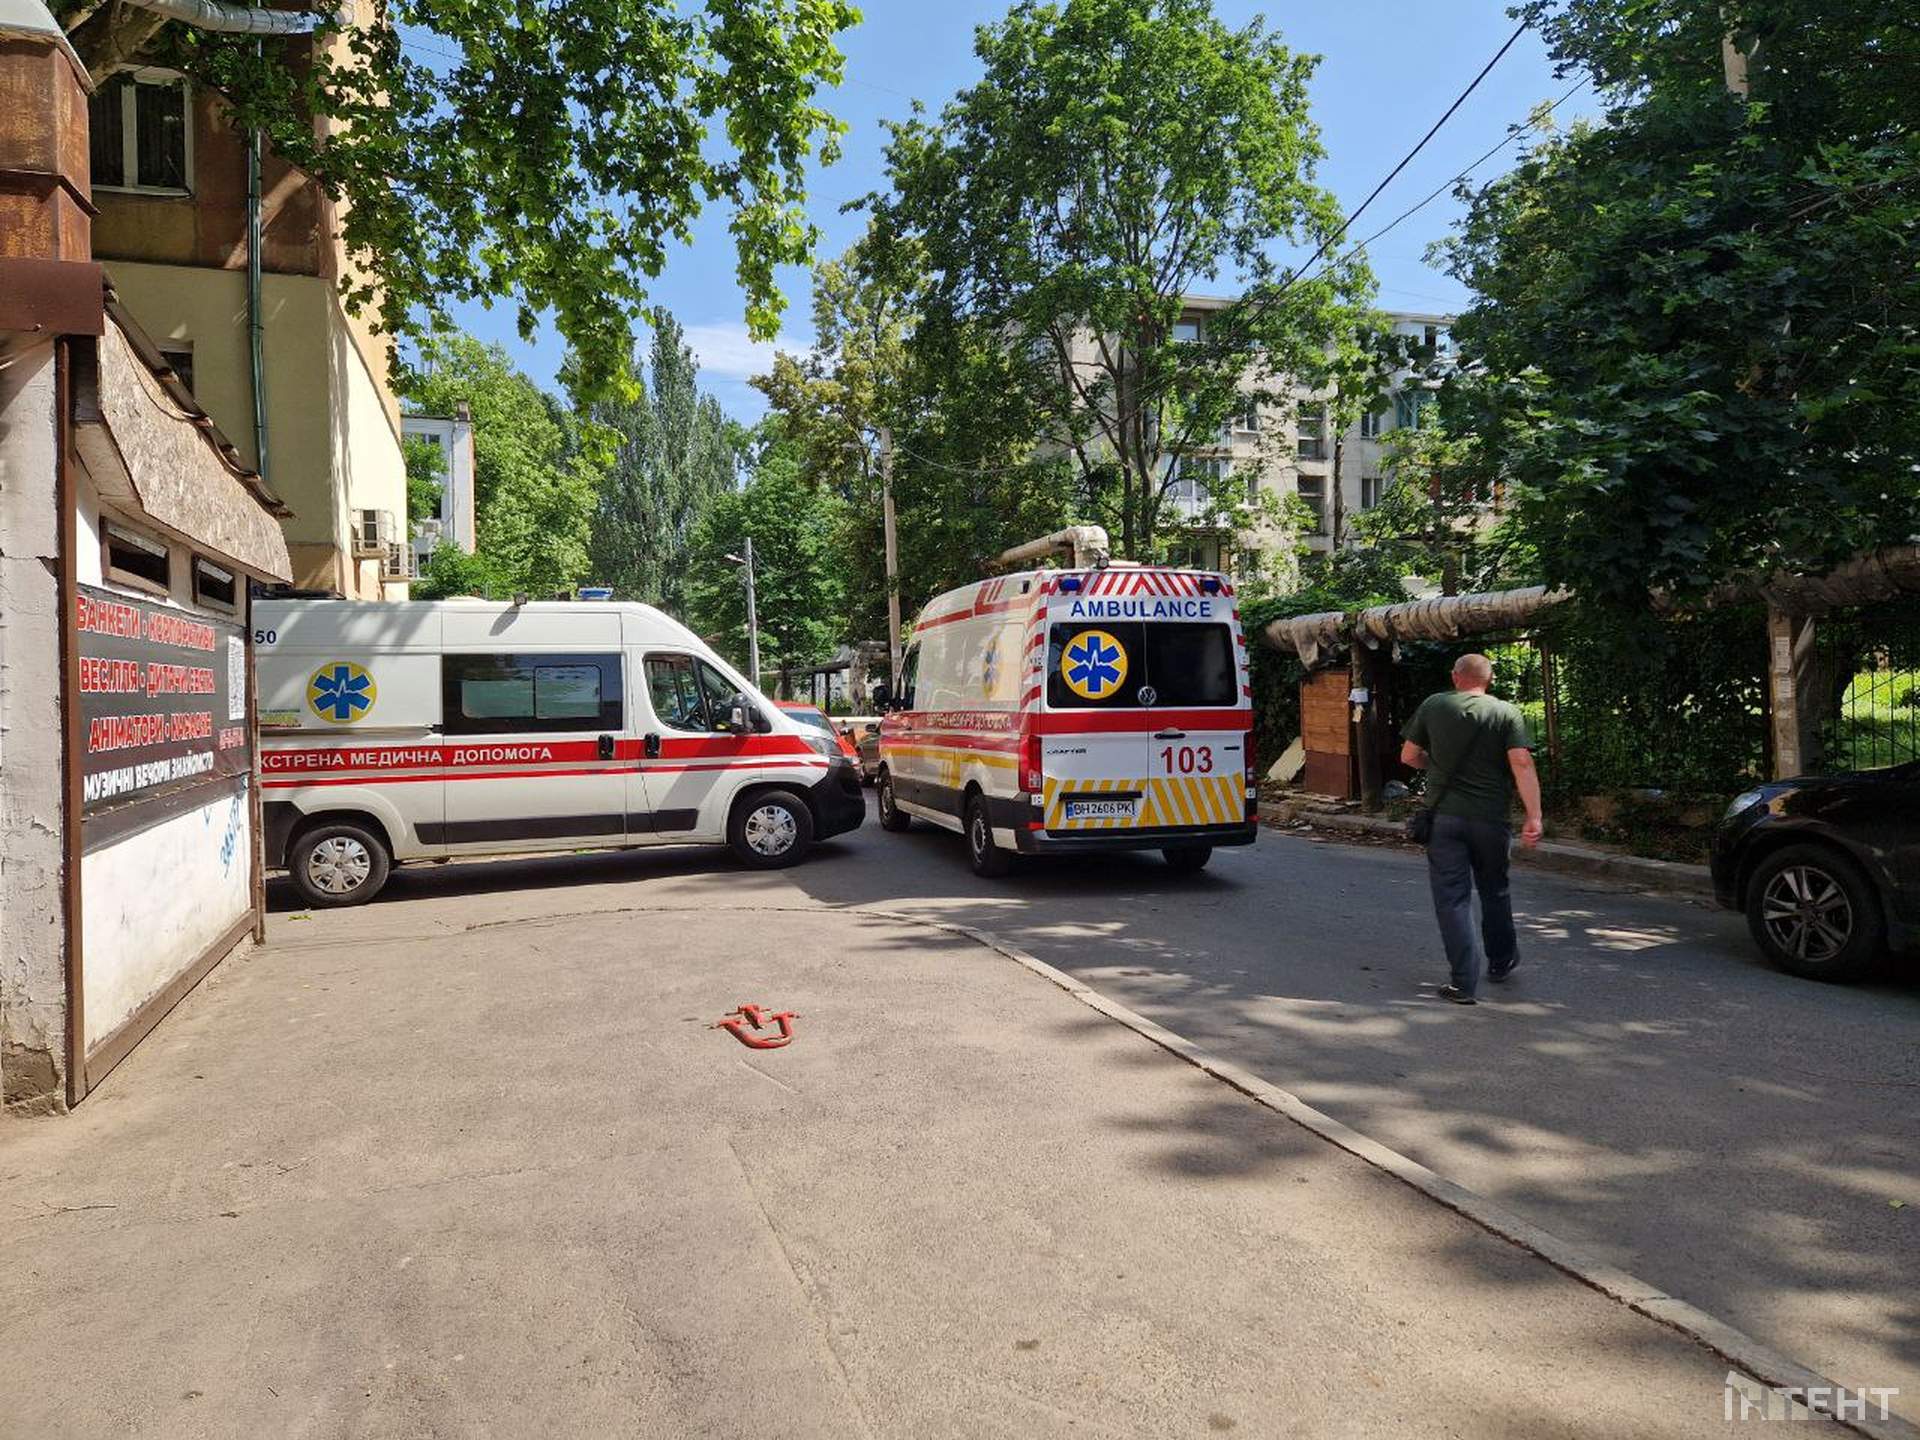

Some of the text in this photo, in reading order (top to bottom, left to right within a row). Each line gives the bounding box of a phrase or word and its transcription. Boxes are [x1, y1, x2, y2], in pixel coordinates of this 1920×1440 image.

[76, 594, 141, 639] БАНКЕТИ
[1071, 601, 1212, 617] AMBULANCE
[255, 630, 277, 644] 50
[79, 656, 139, 693] ВЕСІЛЛЯ
[88, 713, 165, 753] АНІМАТОРИ
[350, 751, 443, 768] МЕДИЧНА
[453, 747, 552, 764] ДОПОМОГА
[1161, 746, 1213, 774] 103
[83, 765, 134, 803] МУЗИЧНІ
[135, 758, 171, 789] ВЕЧОРИ
